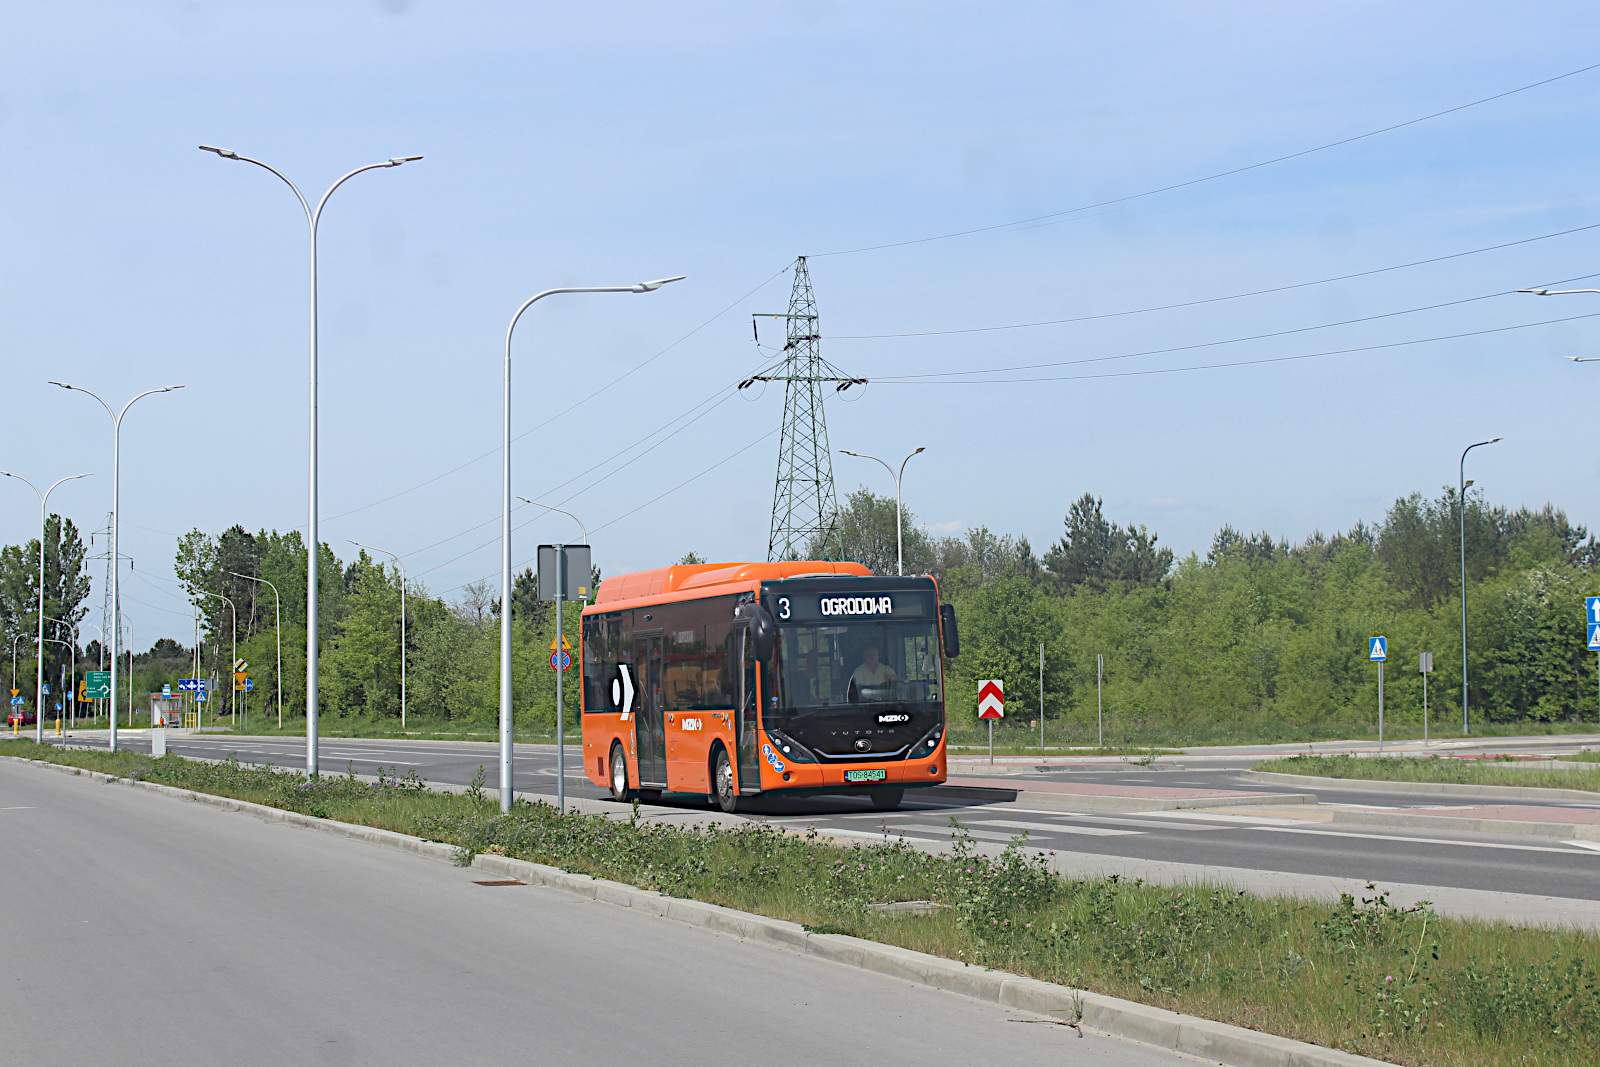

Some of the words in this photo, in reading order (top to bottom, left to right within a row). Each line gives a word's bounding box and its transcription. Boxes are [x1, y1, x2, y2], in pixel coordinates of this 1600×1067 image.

[779, 597, 791, 619] 3
[821, 597, 892, 615] OGRODOWA
[879, 714, 903, 722] MZK
[682, 718, 699, 730] MZK
[848, 771, 862, 779] TOS
[863, 770, 884, 779] 84541
